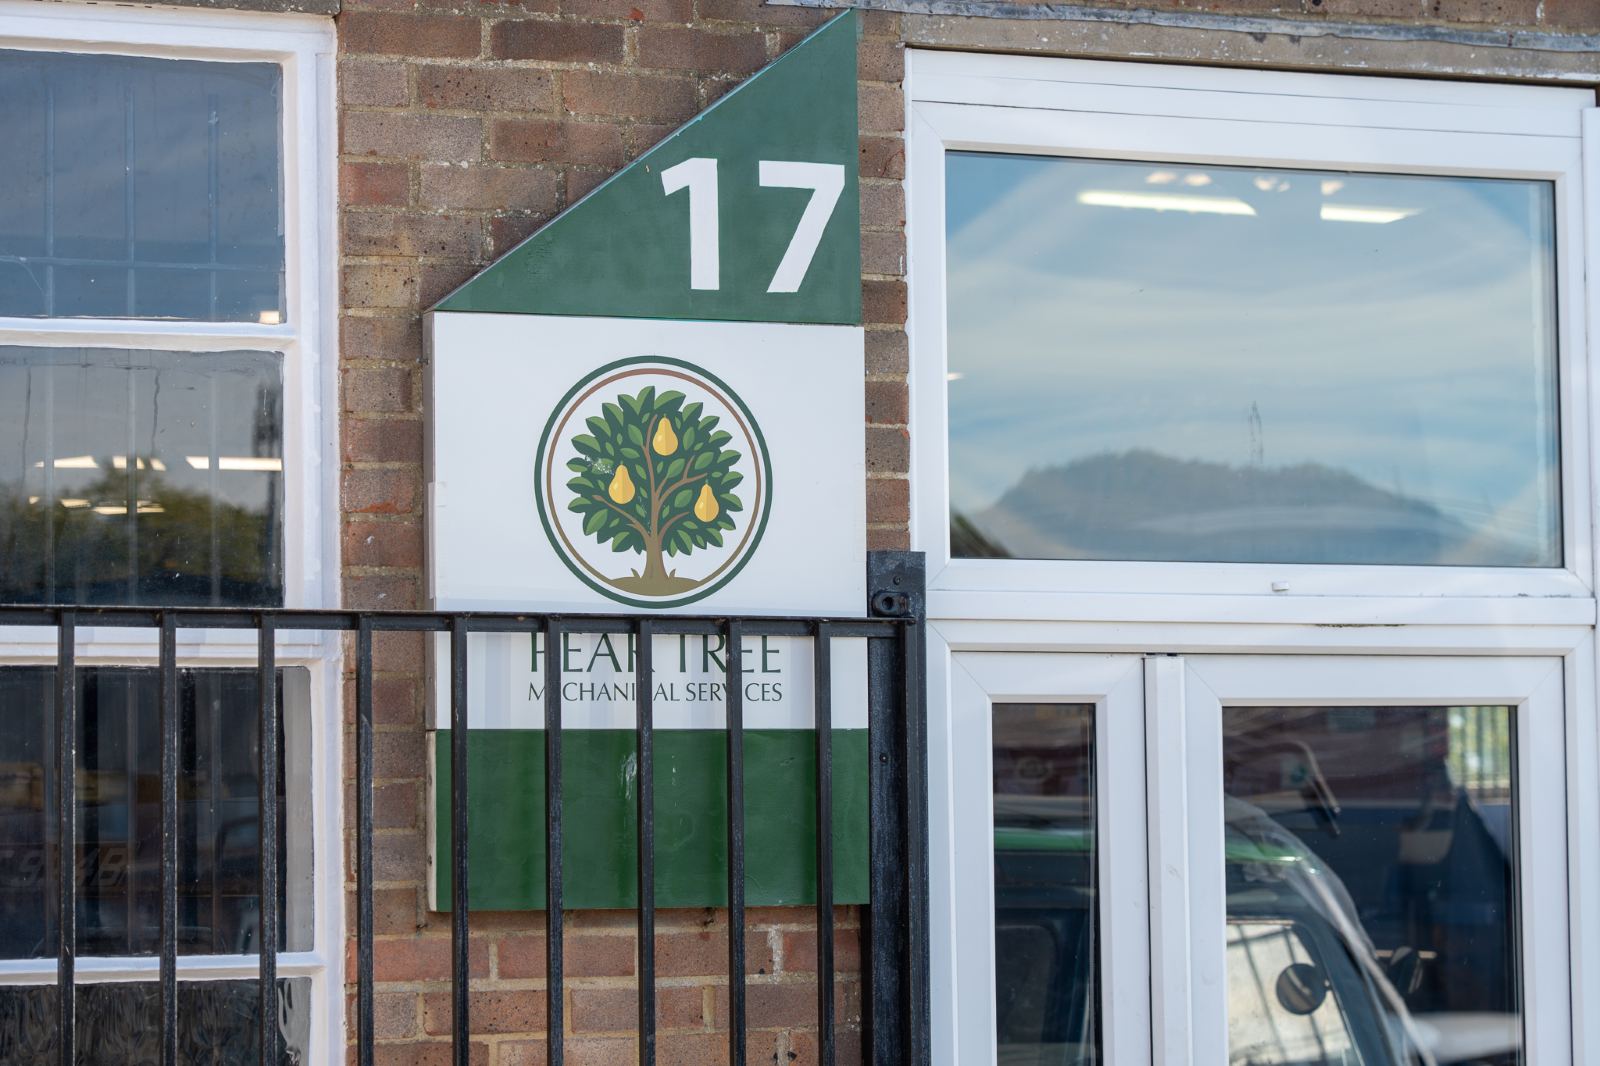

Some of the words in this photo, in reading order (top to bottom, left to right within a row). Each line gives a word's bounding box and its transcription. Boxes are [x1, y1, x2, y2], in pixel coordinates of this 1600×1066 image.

[661, 157, 845, 293] 17
[528, 682, 681, 701] MCHANIAL
[685, 682, 783, 702] SERCES
